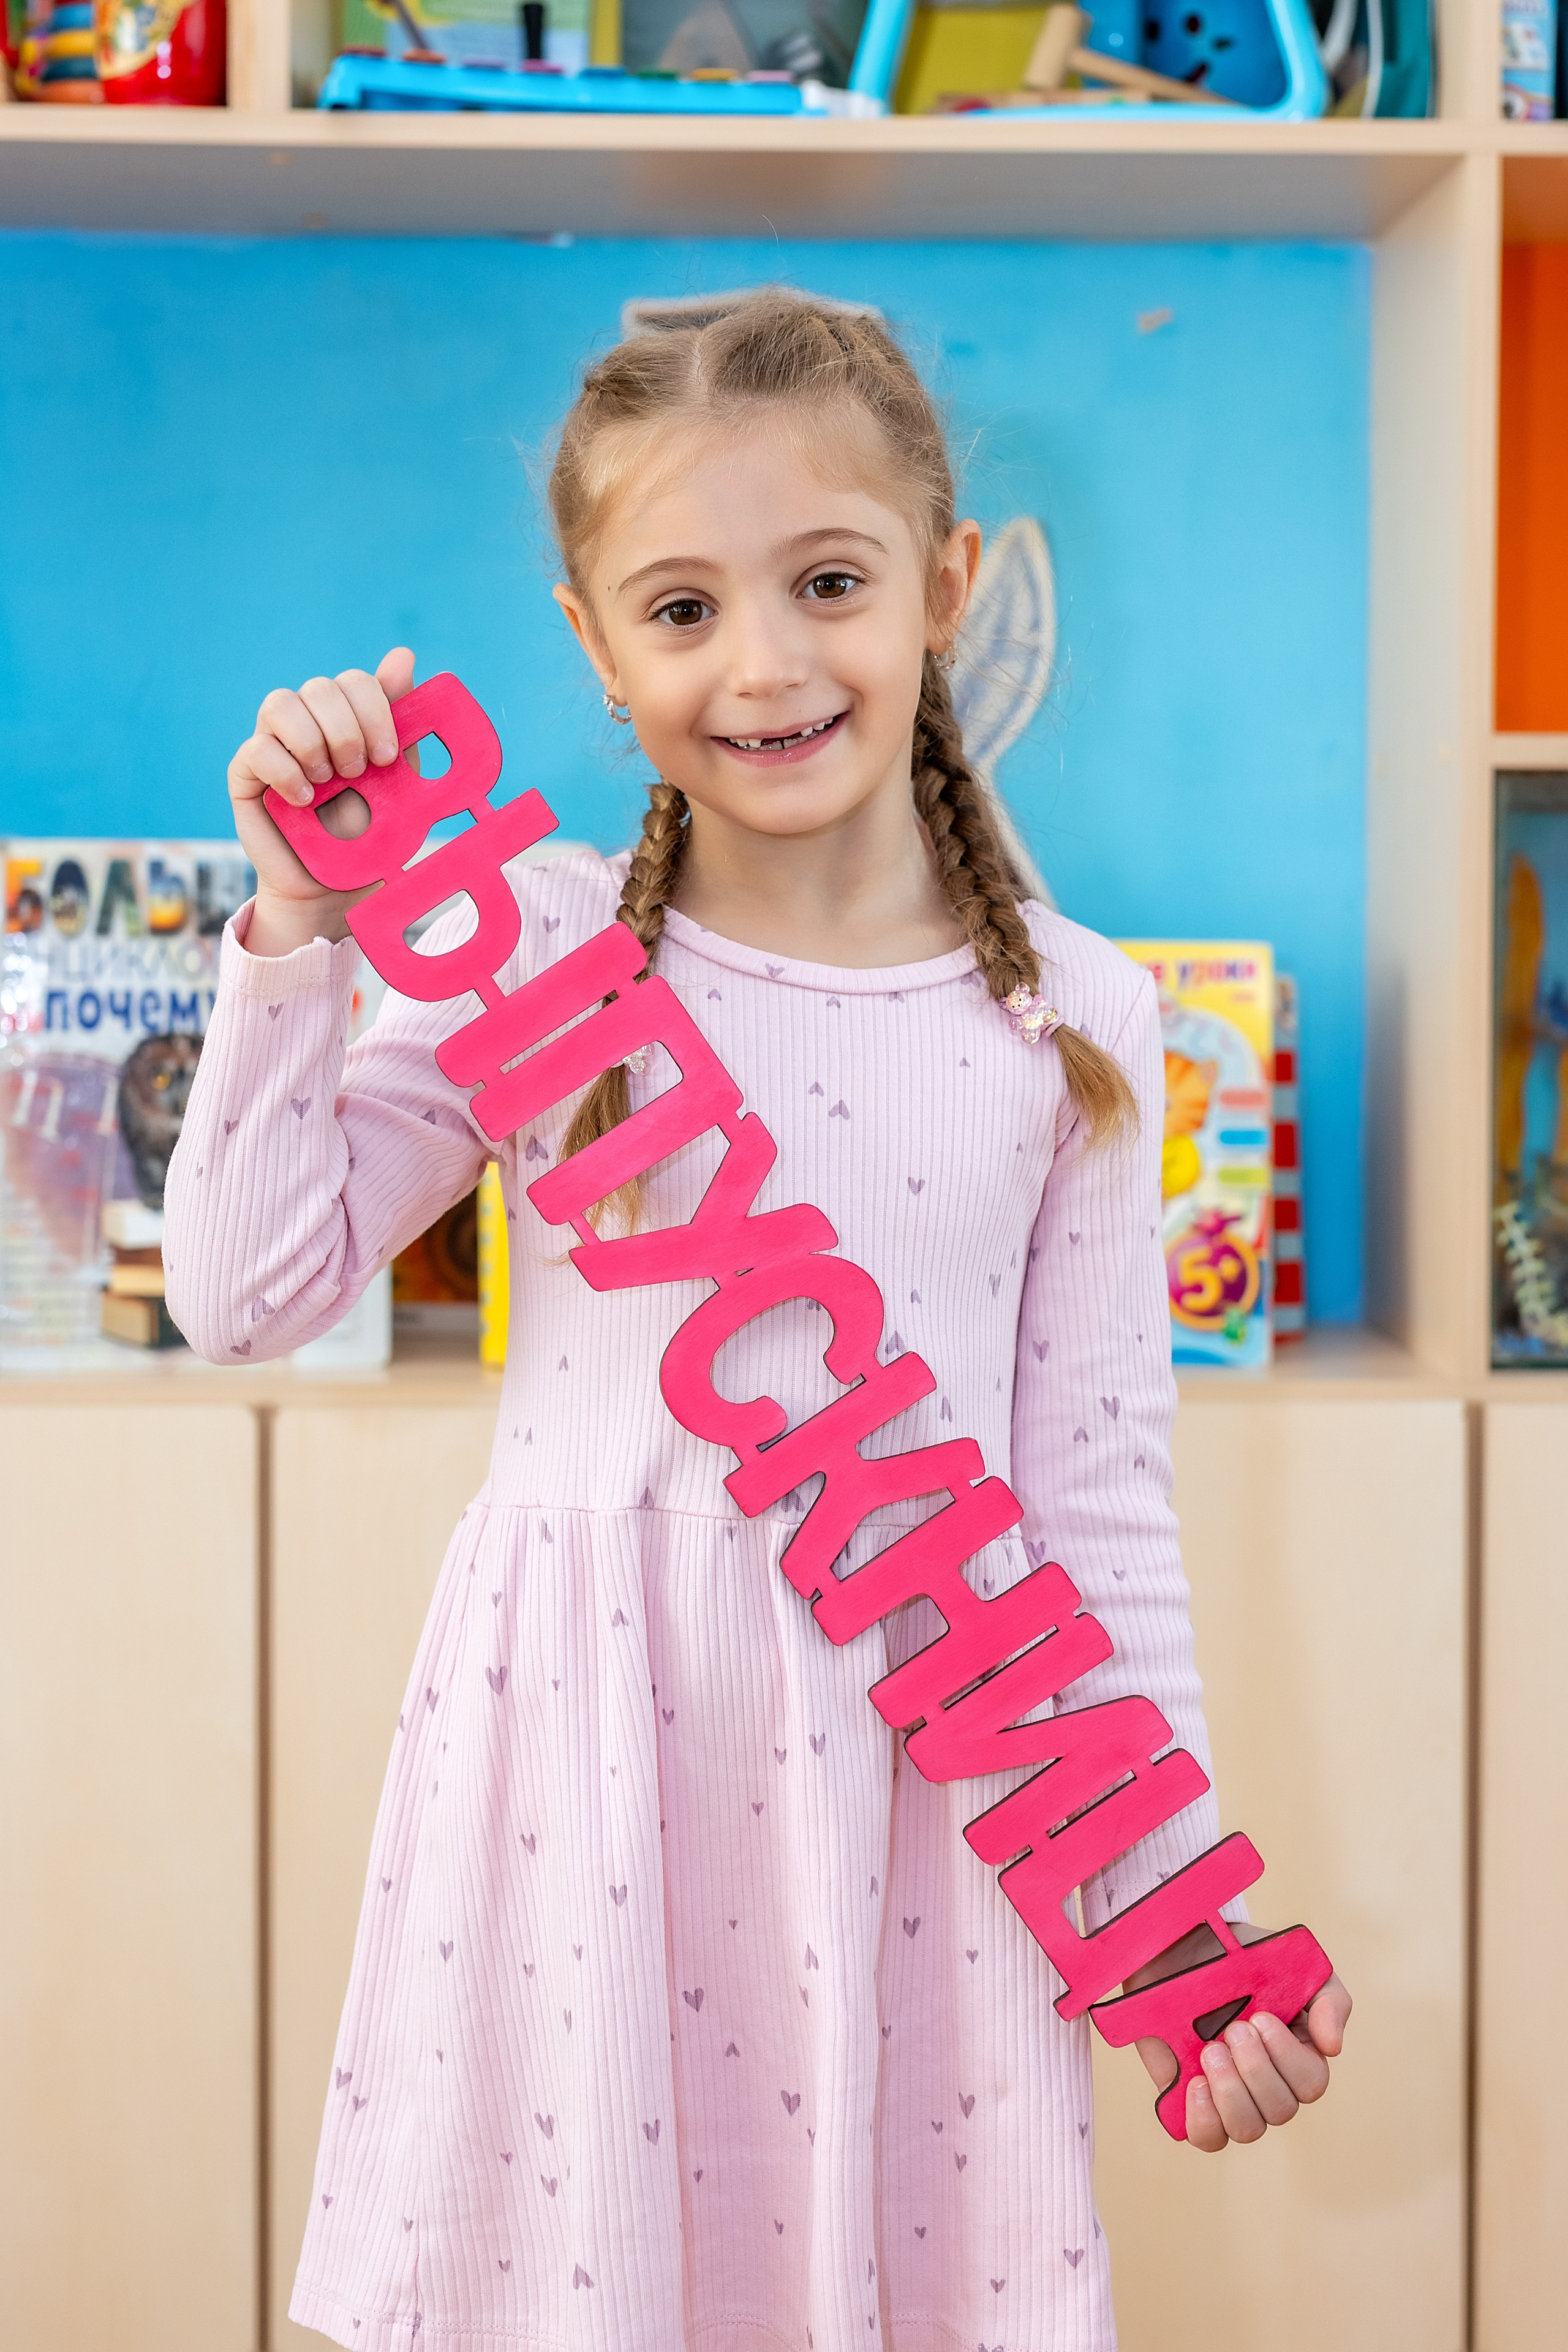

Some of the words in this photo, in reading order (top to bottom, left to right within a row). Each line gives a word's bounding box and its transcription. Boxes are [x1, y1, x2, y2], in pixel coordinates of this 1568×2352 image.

[4, 859, 258, 937] БОЛЬШ
[45, 989, 217, 1035] почем
[263, 672, 1333, 2141] ВЫПУСКНИЦА
